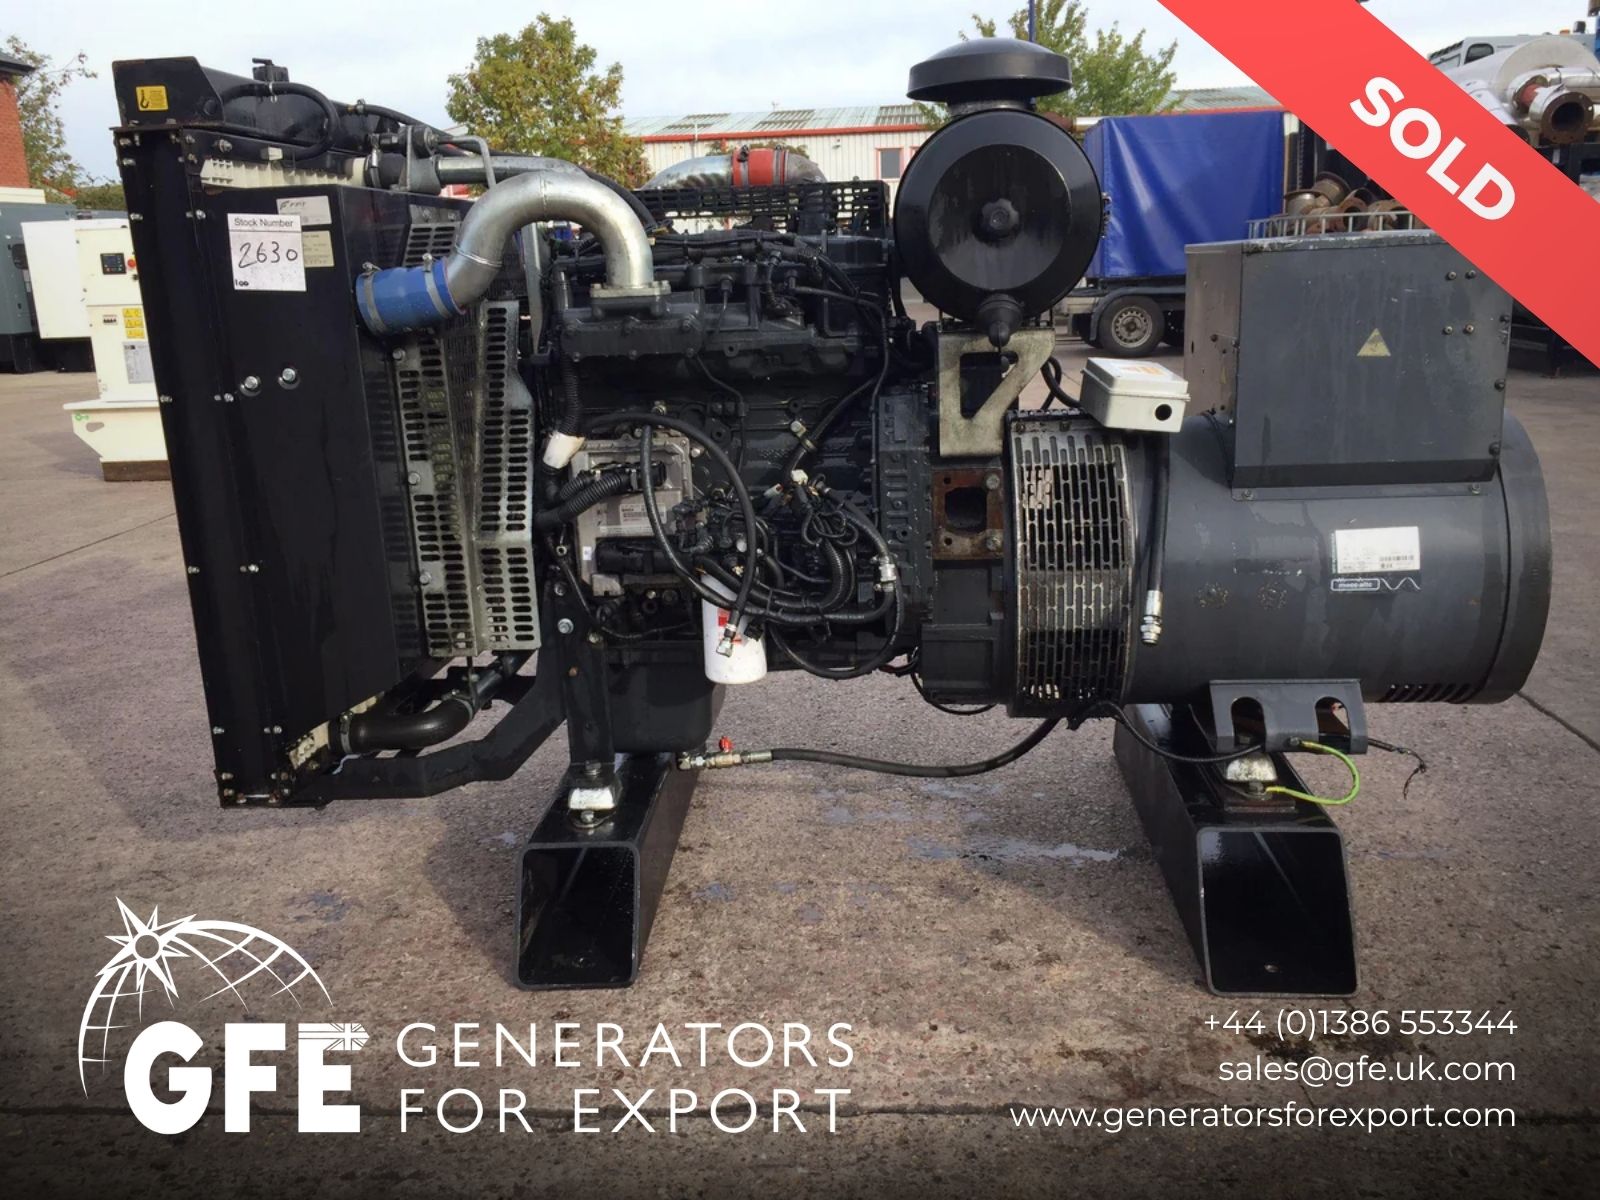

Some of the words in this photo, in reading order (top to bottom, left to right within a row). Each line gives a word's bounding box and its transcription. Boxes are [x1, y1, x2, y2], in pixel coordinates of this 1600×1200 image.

[234, 218, 257, 226] Stock
[260, 219, 294, 227] Number
[238, 240, 298, 268] 2630
